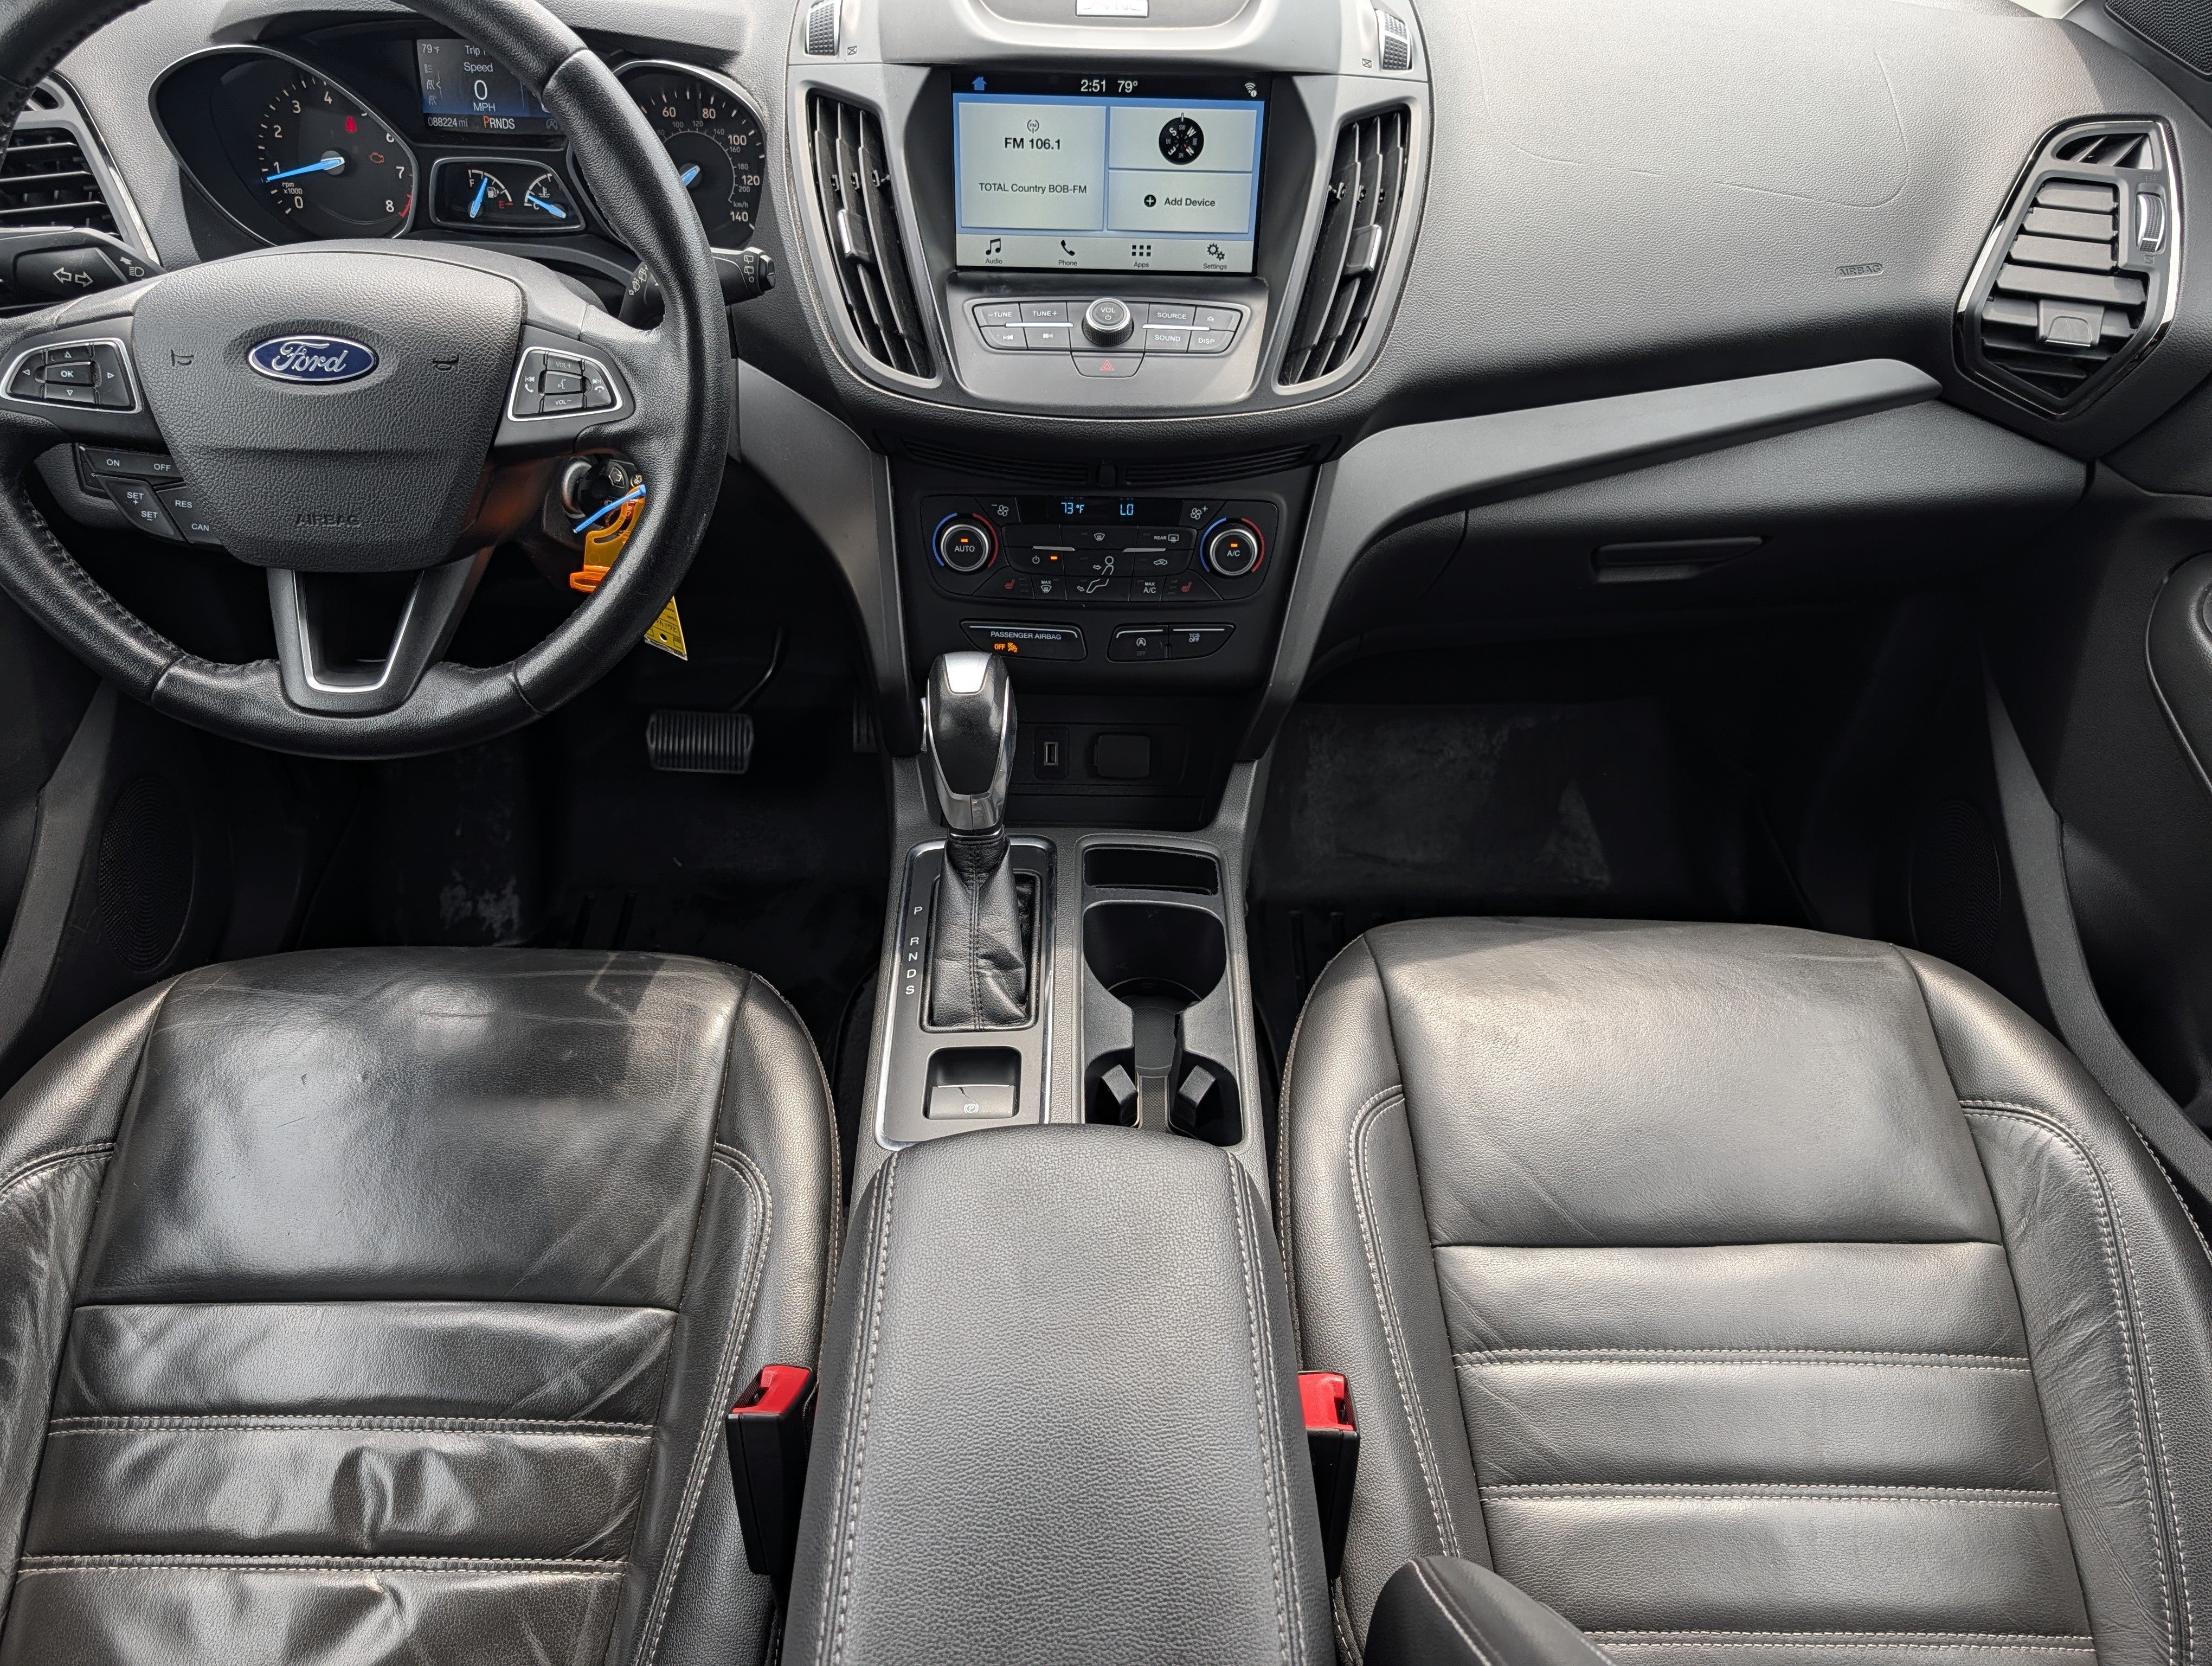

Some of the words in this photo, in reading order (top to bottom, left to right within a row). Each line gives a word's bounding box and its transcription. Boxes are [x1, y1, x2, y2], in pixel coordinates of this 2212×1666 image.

[464, 45, 480, 57] Trip
[464, 61, 493, 73] Speed
[474, 80, 487, 100] 0
[1081, 79, 1107, 92] 2:51
[1117, 80, 1138, 93] 79°
[325, 93, 333, 104] 4
[291, 101, 301, 113] 3
[473, 102, 496, 112] MPH
[662, 107, 676, 118] 60
[703, 108, 716, 119] 80
[428, 117, 458, 127] 088224
[459, 118, 468, 127] mi
[273, 126, 282, 138] 2
[1169, 127, 1177, 136] S
[1187, 127, 1197, 137] W
[728, 135, 747, 145] 100
[1005, 138, 1024, 149] FM
[1029, 138, 1061, 150] 106.1
[1186, 146, 1194, 156] N
[273, 162, 280, 174] 1
[396, 166, 404, 179] 7
[470, 179, 474, 187] F
[742, 175, 760, 185] 120
[979, 182, 1009, 193] TOTAL
[1011, 183, 1046, 195] Country
[1049, 184, 1087, 194] BOB-FM
[294, 196, 304, 209] 0
[385, 201, 394, 212] 8
[498, 201, 505, 209] E
[1164, 198, 1182, 206] Add
[1185, 198, 1216, 207] Device
[730, 212, 748, 222] 140
[1840, 265, 1880, 275] AIRBAG
[1157, 312, 1187, 320] SOURCE
[272, 342, 348, 372] Ford
[106, 459, 120, 467] ON
[153, 463, 171, 472] OFF
[175, 499, 192, 508] RES
[141, 510, 158, 518] SET
[191, 523, 209, 531] CAN
[914, 906, 923, 914] P
[910, 937, 919, 945] R
[909, 952, 918, 962] N
[907, 969, 917, 978] D
[905, 985, 915, 995] S
